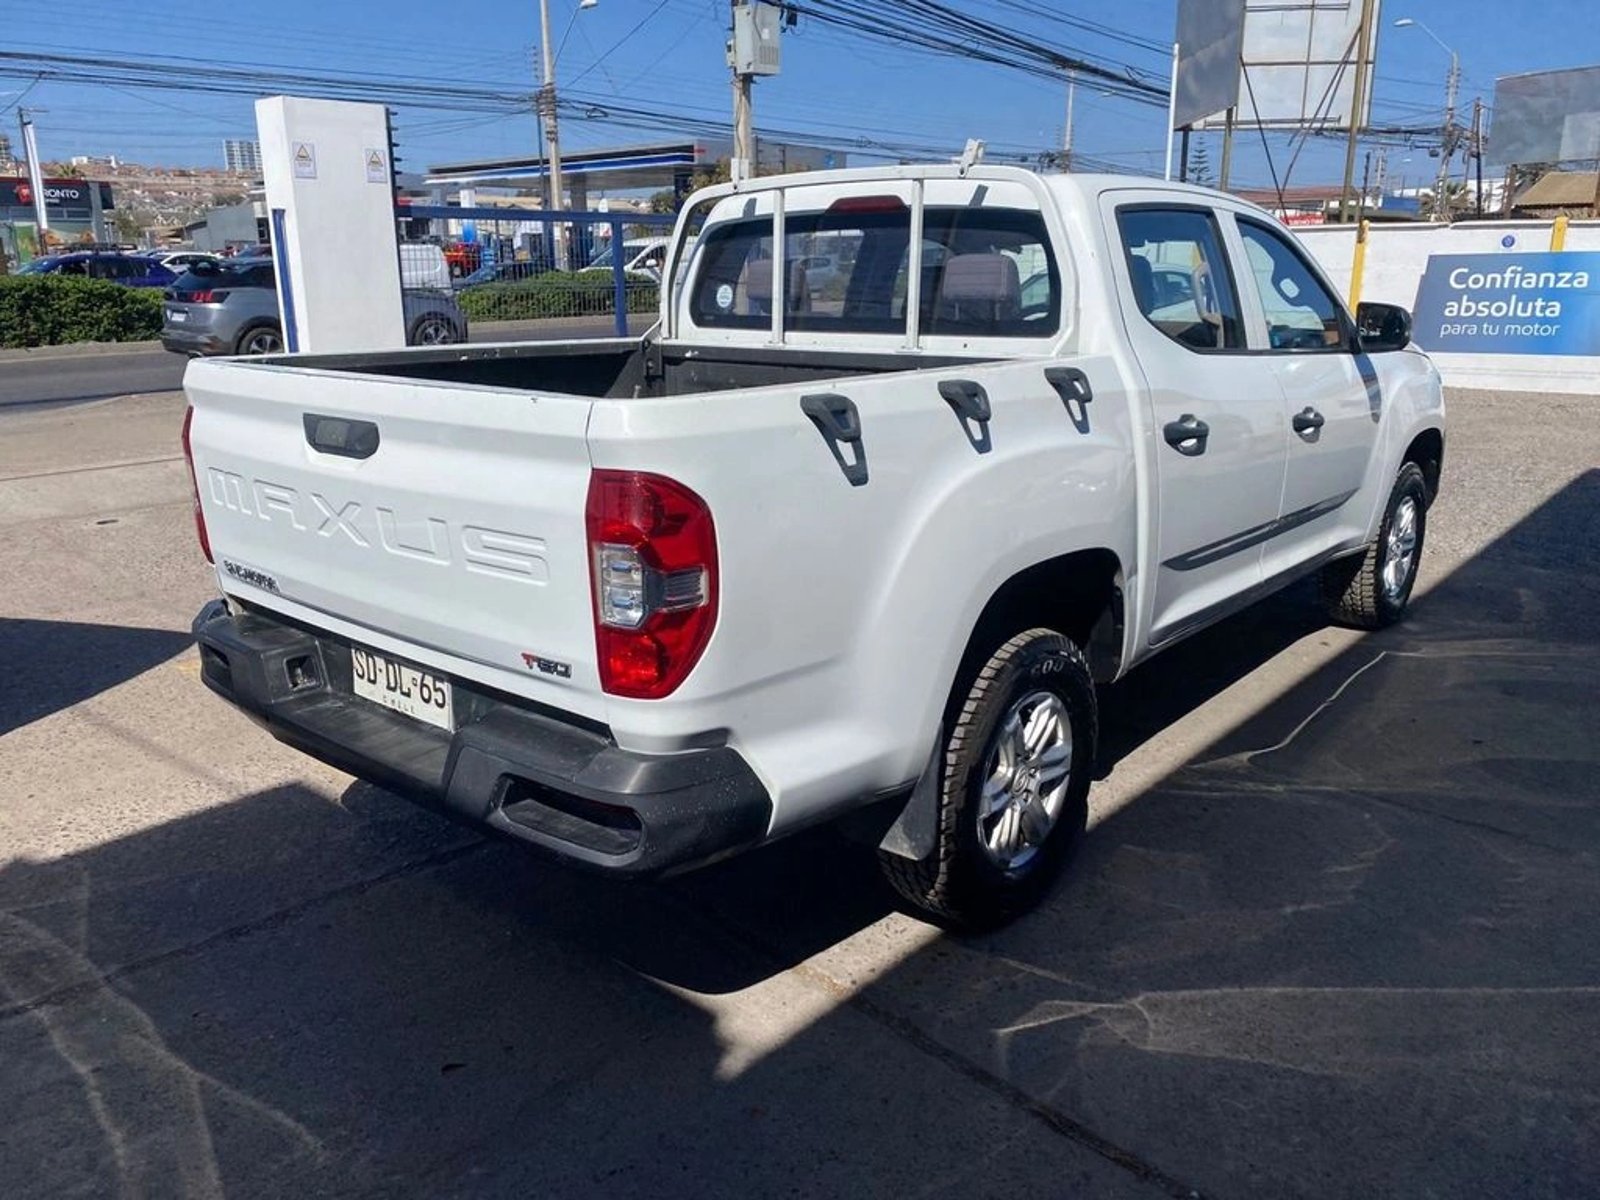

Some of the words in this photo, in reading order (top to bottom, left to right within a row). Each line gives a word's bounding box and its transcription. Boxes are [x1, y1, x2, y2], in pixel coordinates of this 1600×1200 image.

[42, 188, 79, 199] RONTO
[1449, 265, 1589, 290] Confianza
[1443, 294, 1561, 318] absoluta
[1439, 323, 1478, 338] para
[1482, 322, 1499, 335] tu
[1503, 322, 1561, 337] motor
[207, 466, 550, 588] MAXUS
